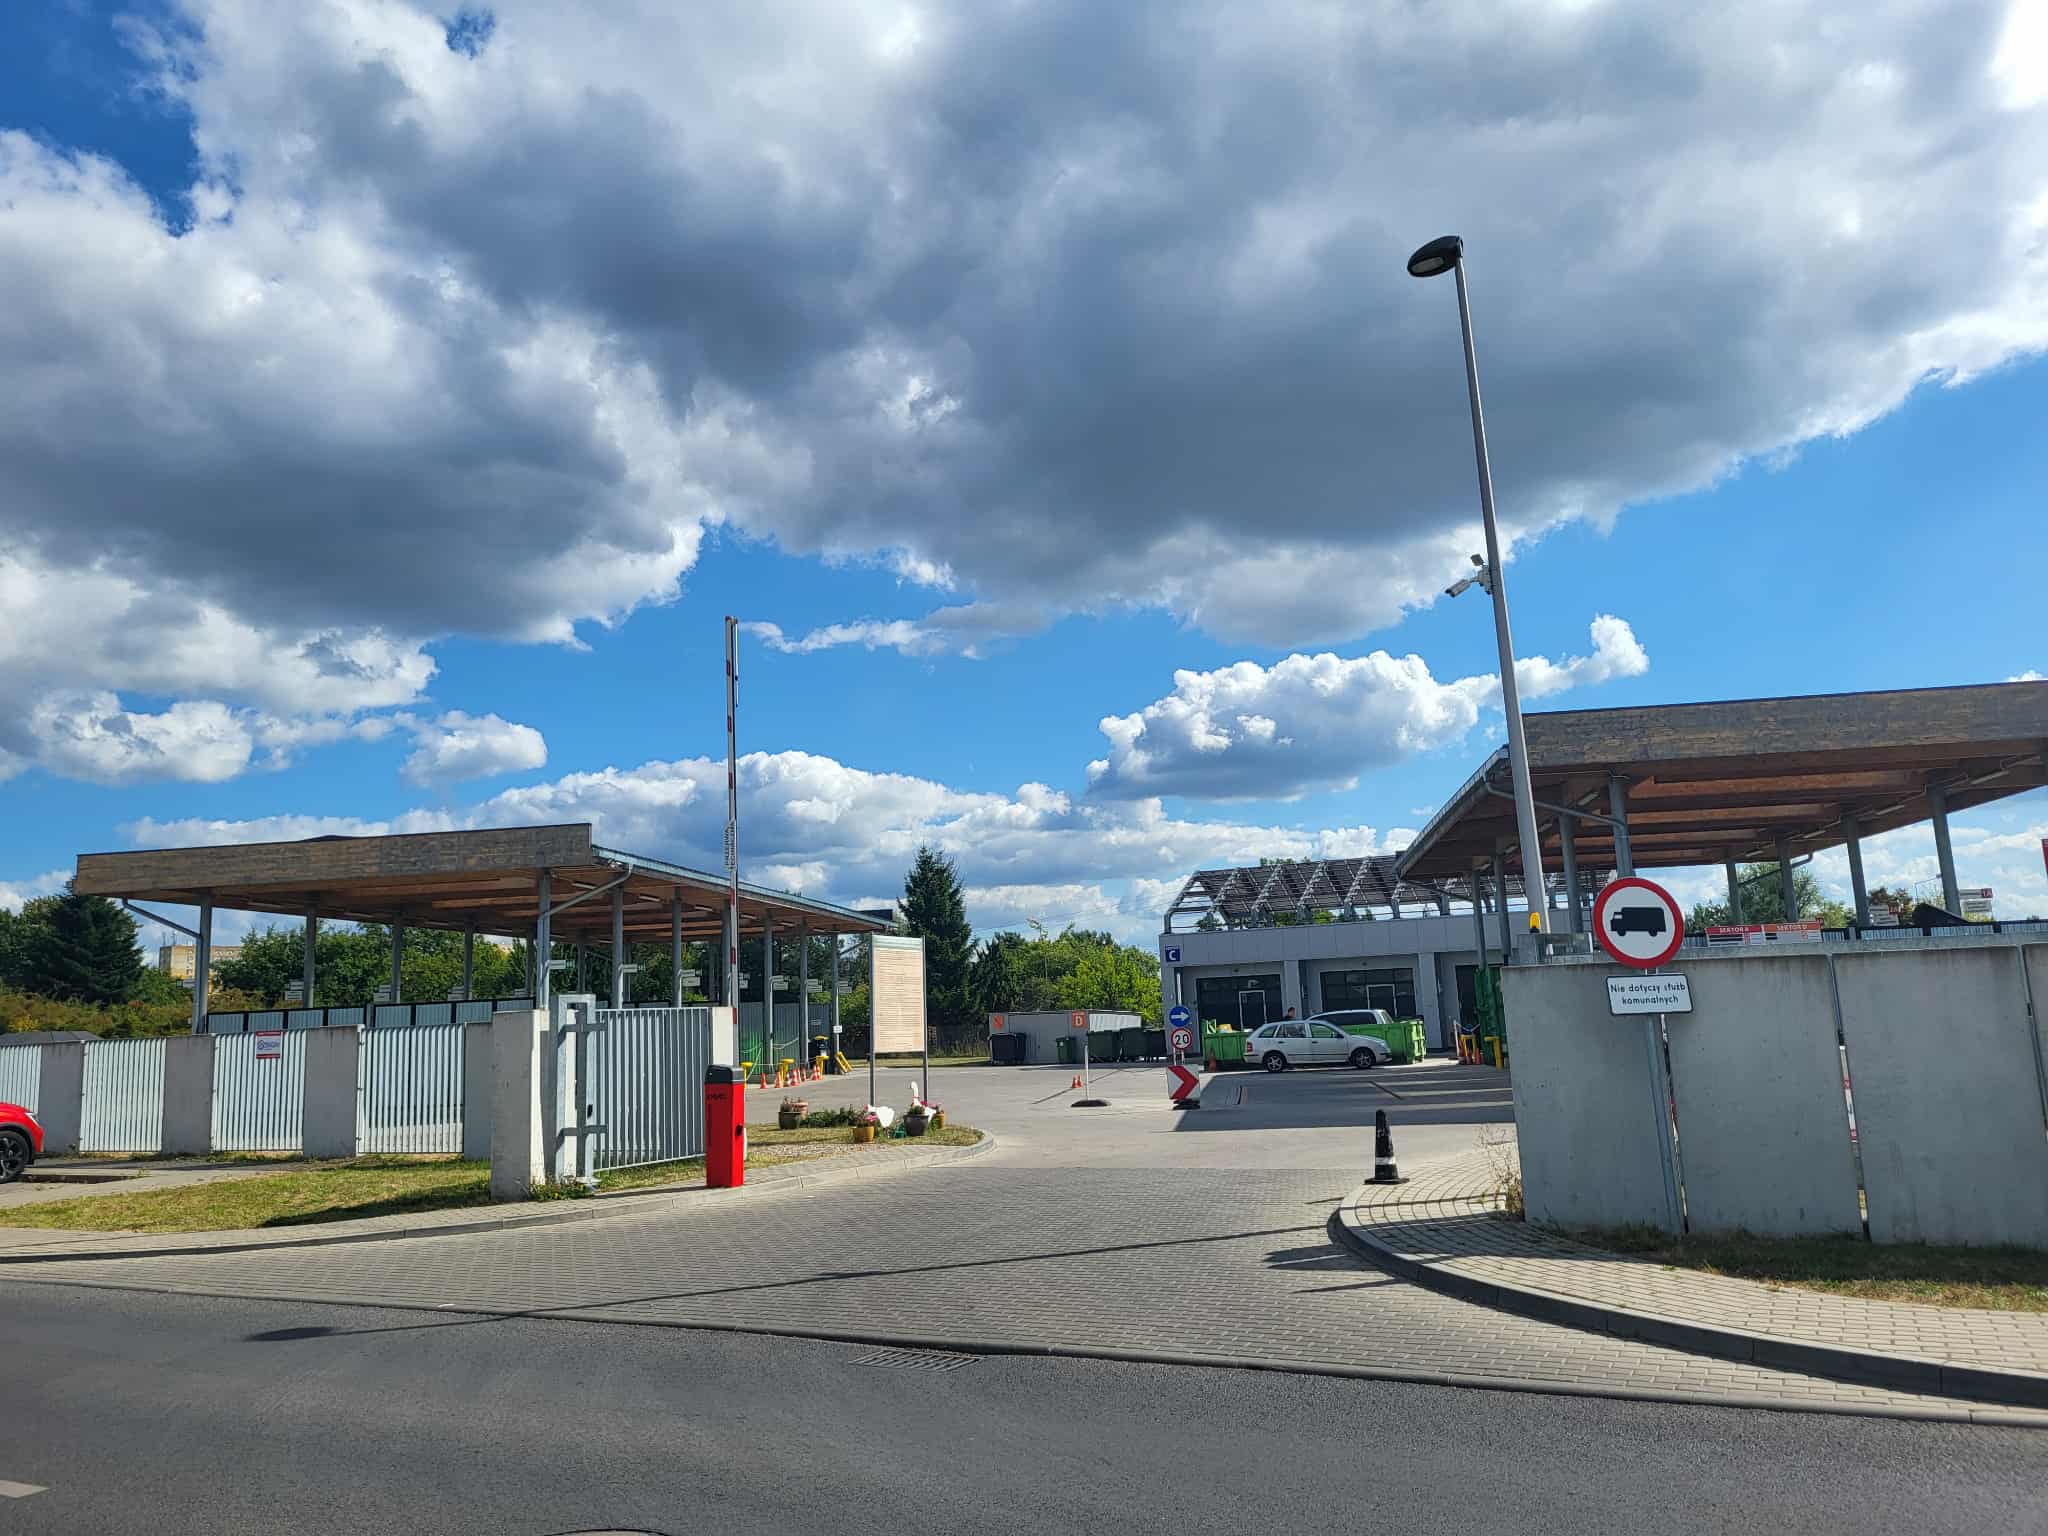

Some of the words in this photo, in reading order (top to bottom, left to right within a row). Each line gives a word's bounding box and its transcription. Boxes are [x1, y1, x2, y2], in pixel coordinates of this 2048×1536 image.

[1168, 950, 1176, 960] C
[1610, 984, 1625, 992] Nie
[1628, 984, 1660, 994] dotyczy
[1622, 993, 1679, 1005] komunalnych
[1174, 1034, 1189, 1045] 20
